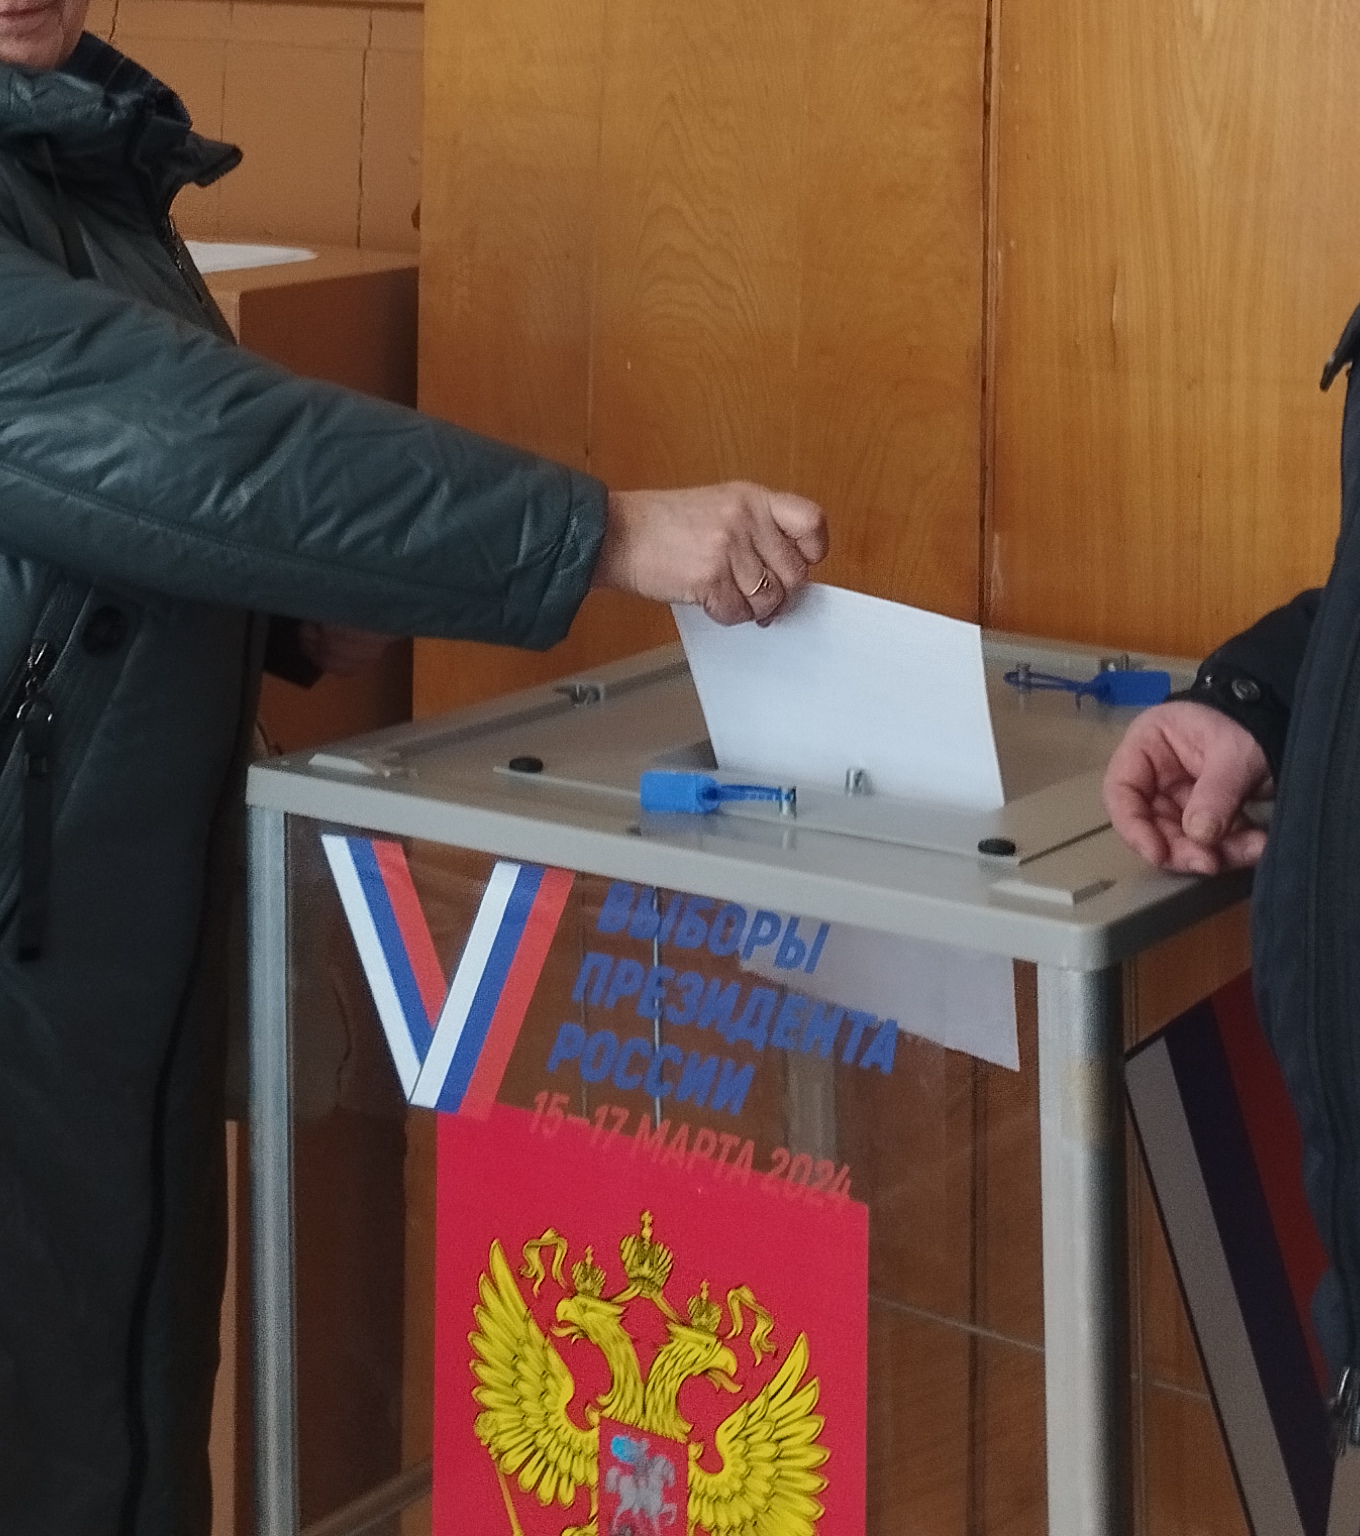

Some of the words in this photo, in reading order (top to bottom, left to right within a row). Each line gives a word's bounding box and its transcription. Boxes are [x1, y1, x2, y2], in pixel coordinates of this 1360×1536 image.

[595, 880, 831, 974] ВЫБОРЫ
[571, 952, 898, 1076] ПРЕЗИДЕНТА
[546, 1022, 755, 1115] РОССИИ
[630, 1113, 755, 1188] МАРТА
[760, 1147, 852, 1209] 2024
